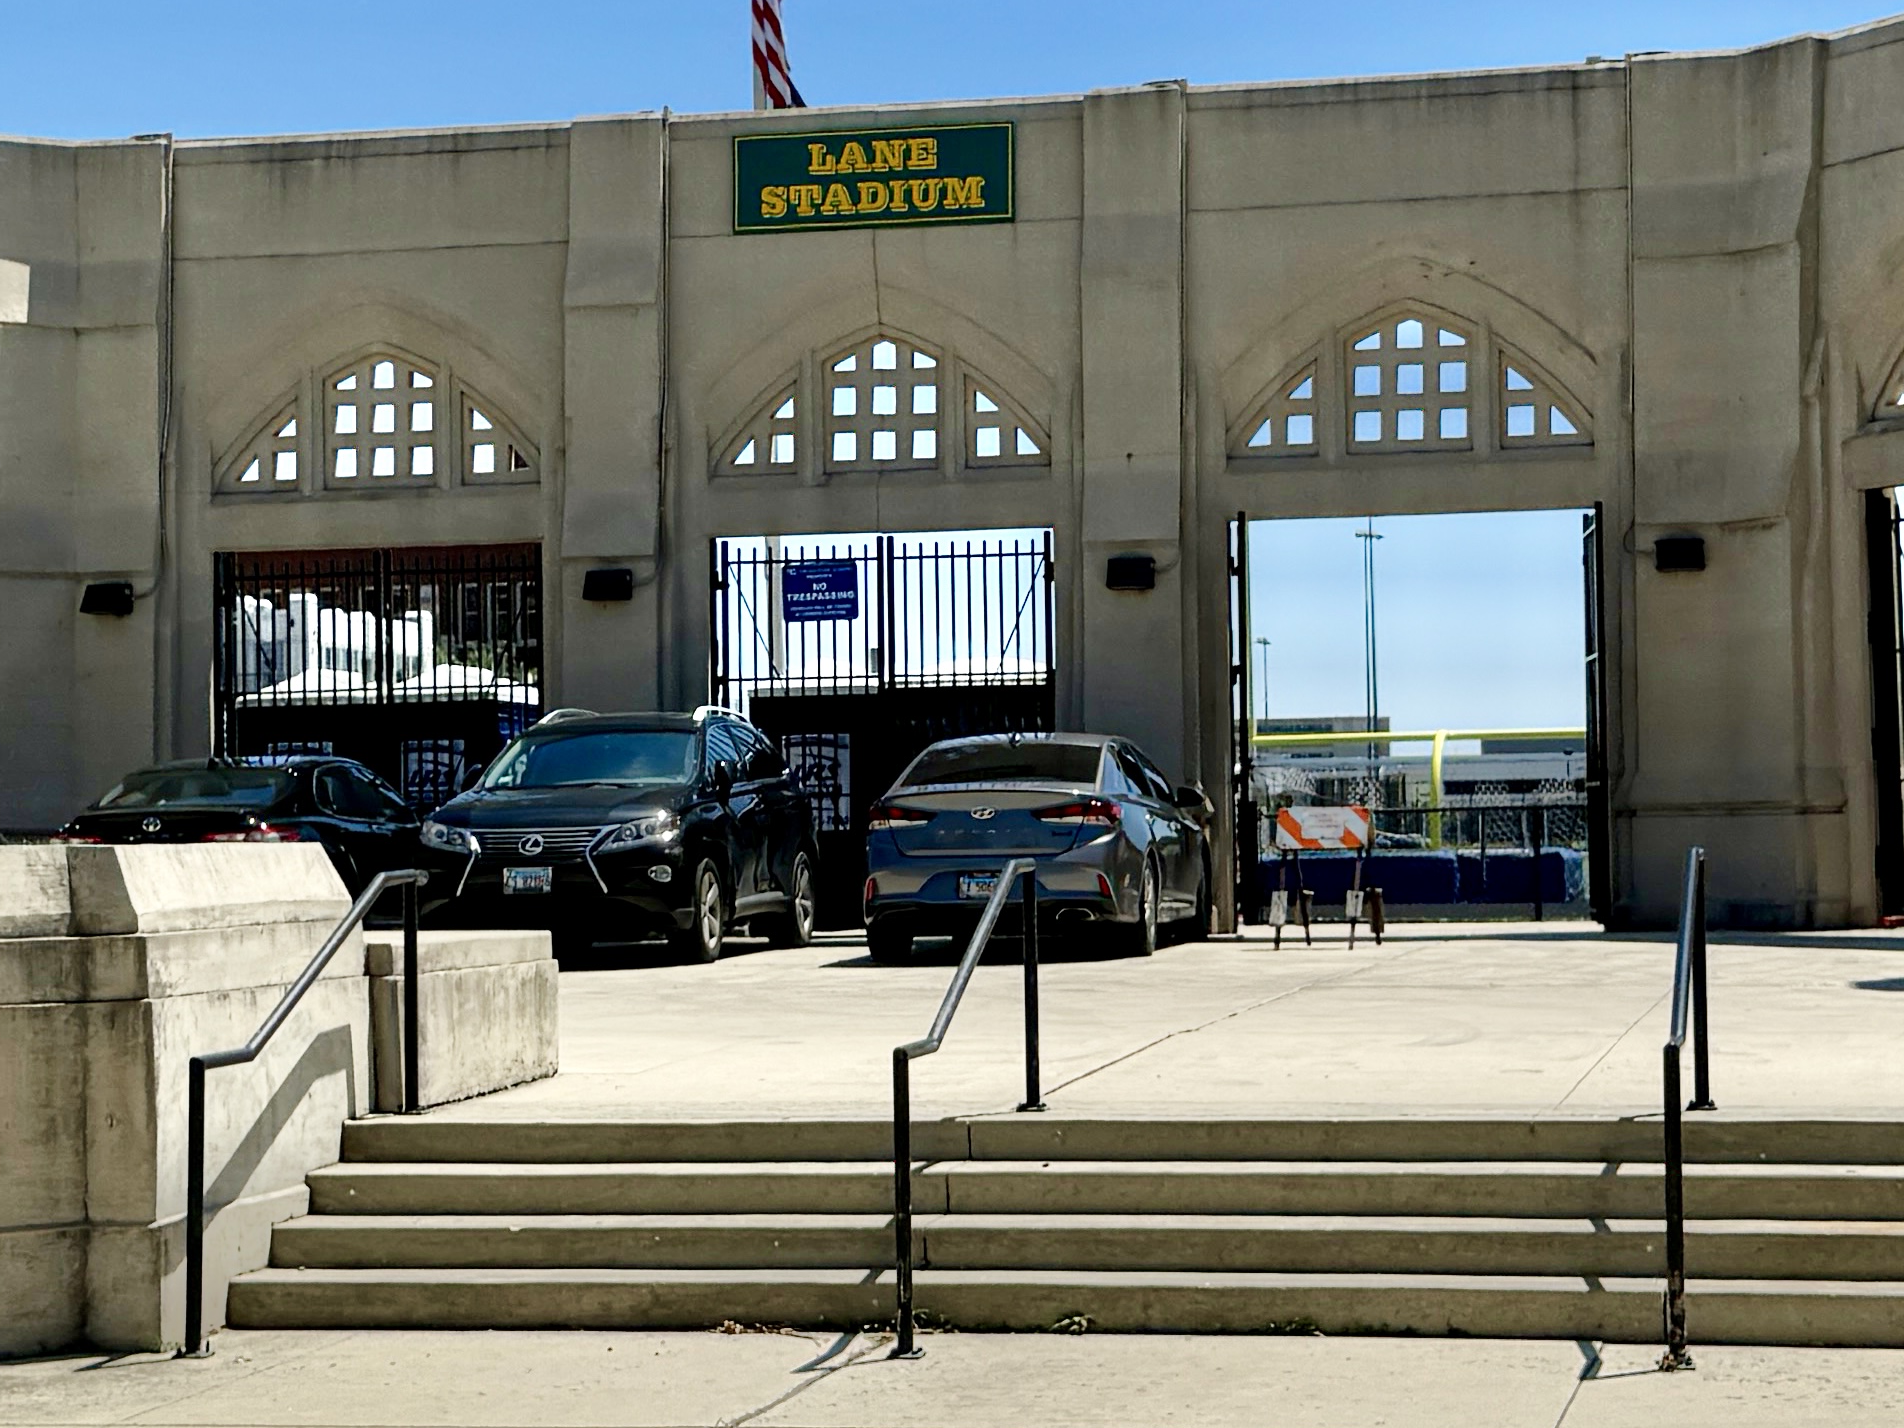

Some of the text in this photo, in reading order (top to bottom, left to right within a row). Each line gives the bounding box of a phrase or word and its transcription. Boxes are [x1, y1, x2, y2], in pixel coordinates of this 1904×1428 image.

[807, 137, 938, 175] LANE
[760, 176, 986, 218] STADIUM
[787, 591, 855, 601] TRESPASSING
[813, 582, 827, 591] NO
